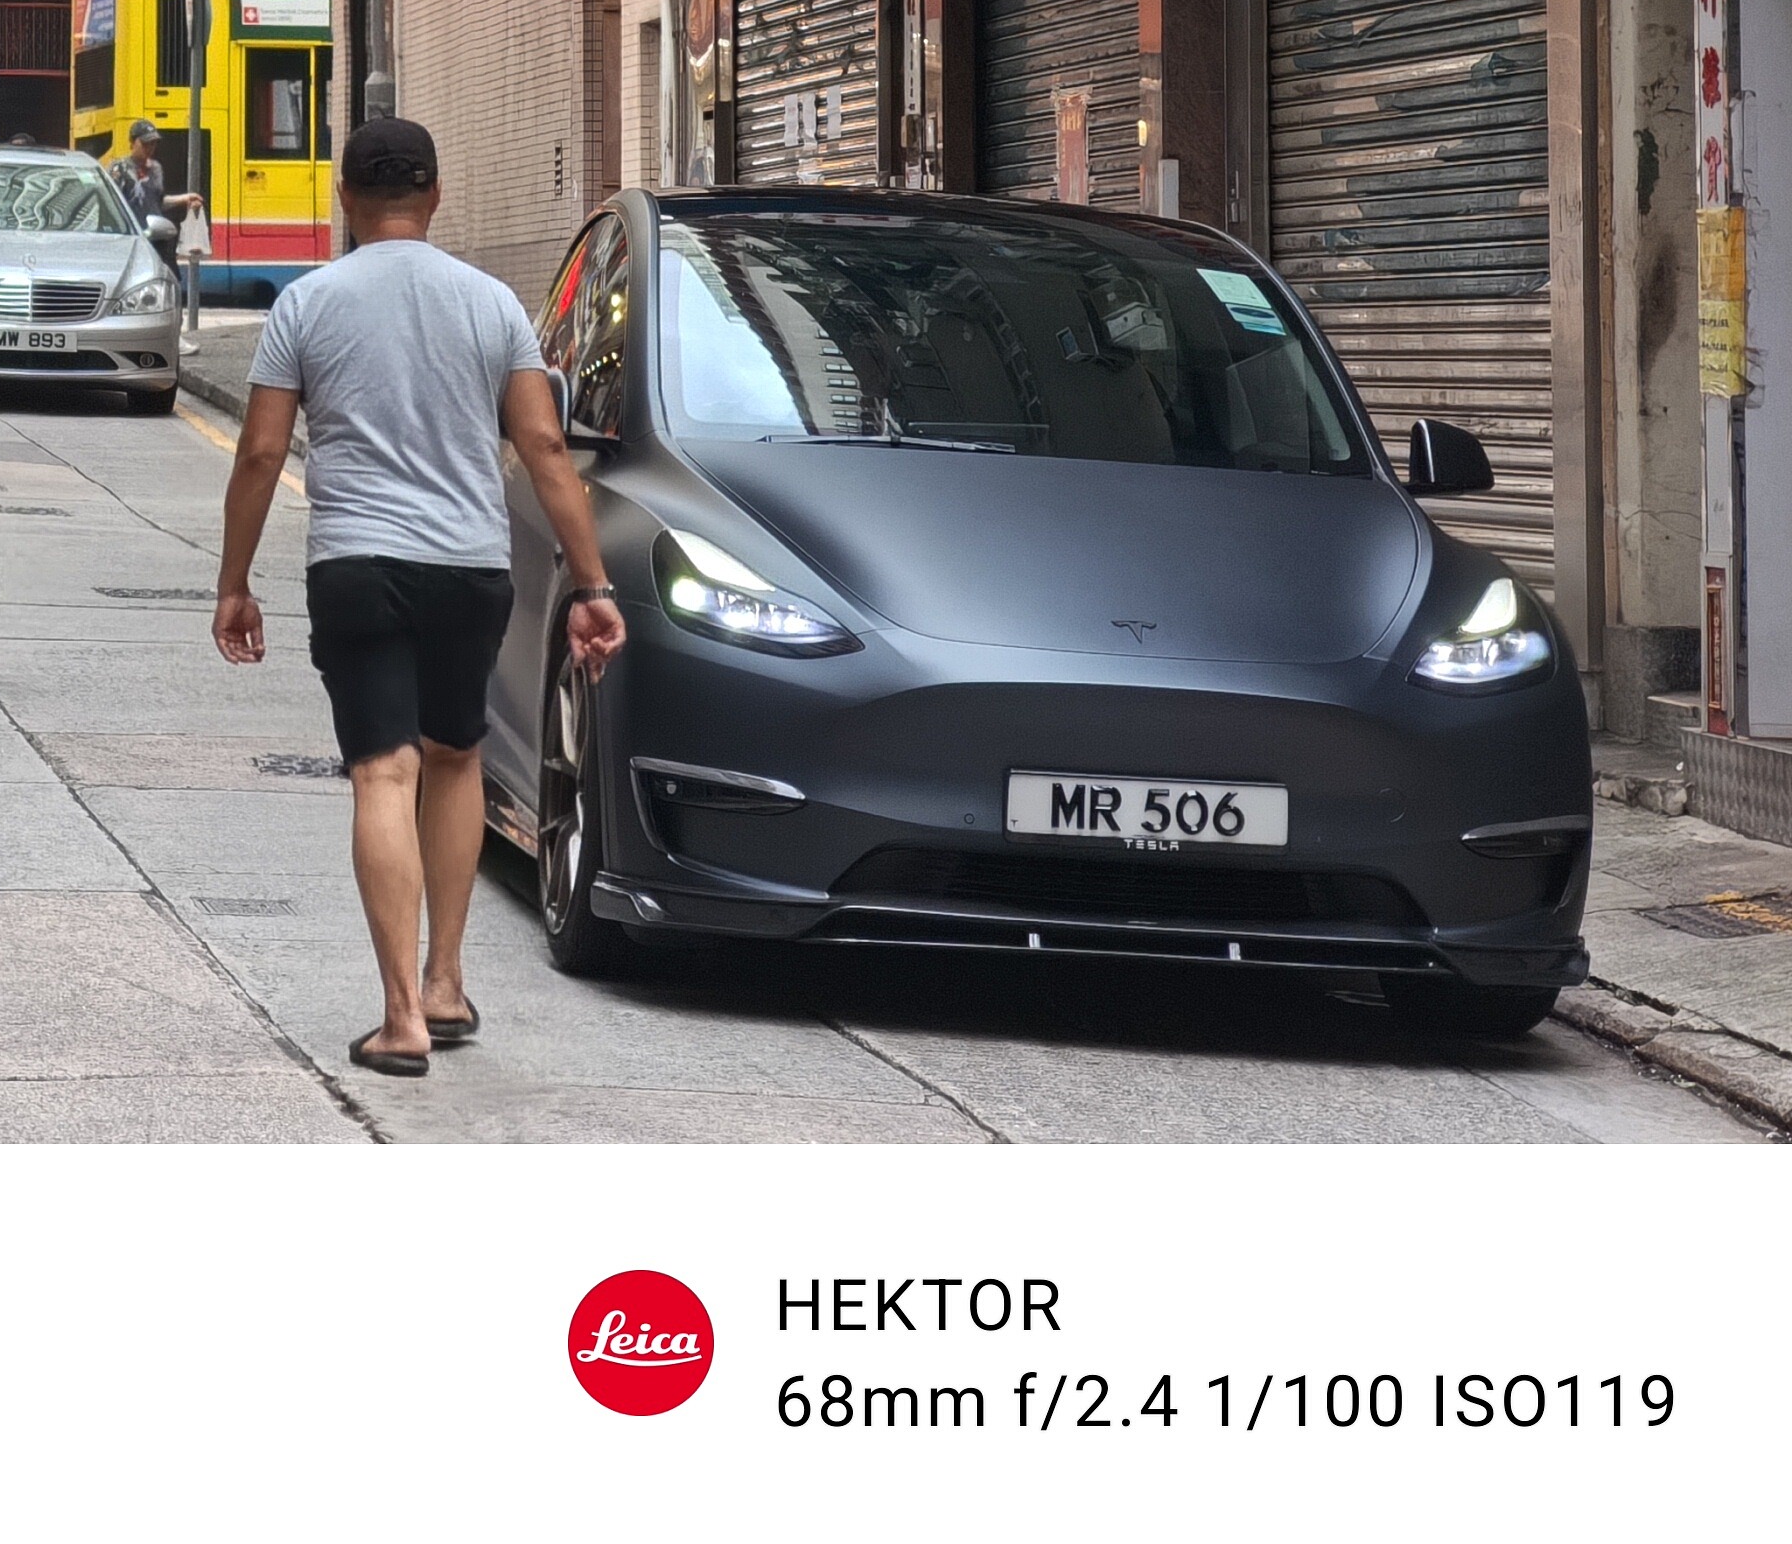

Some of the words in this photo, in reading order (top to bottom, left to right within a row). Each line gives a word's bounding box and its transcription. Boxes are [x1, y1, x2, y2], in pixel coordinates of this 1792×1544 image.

[28, 332, 66, 348] 893
[1050, 782, 1122, 832] MR
[1140, 788, 1246, 837] 506
[1123, 839, 1179, 851] TESLA
